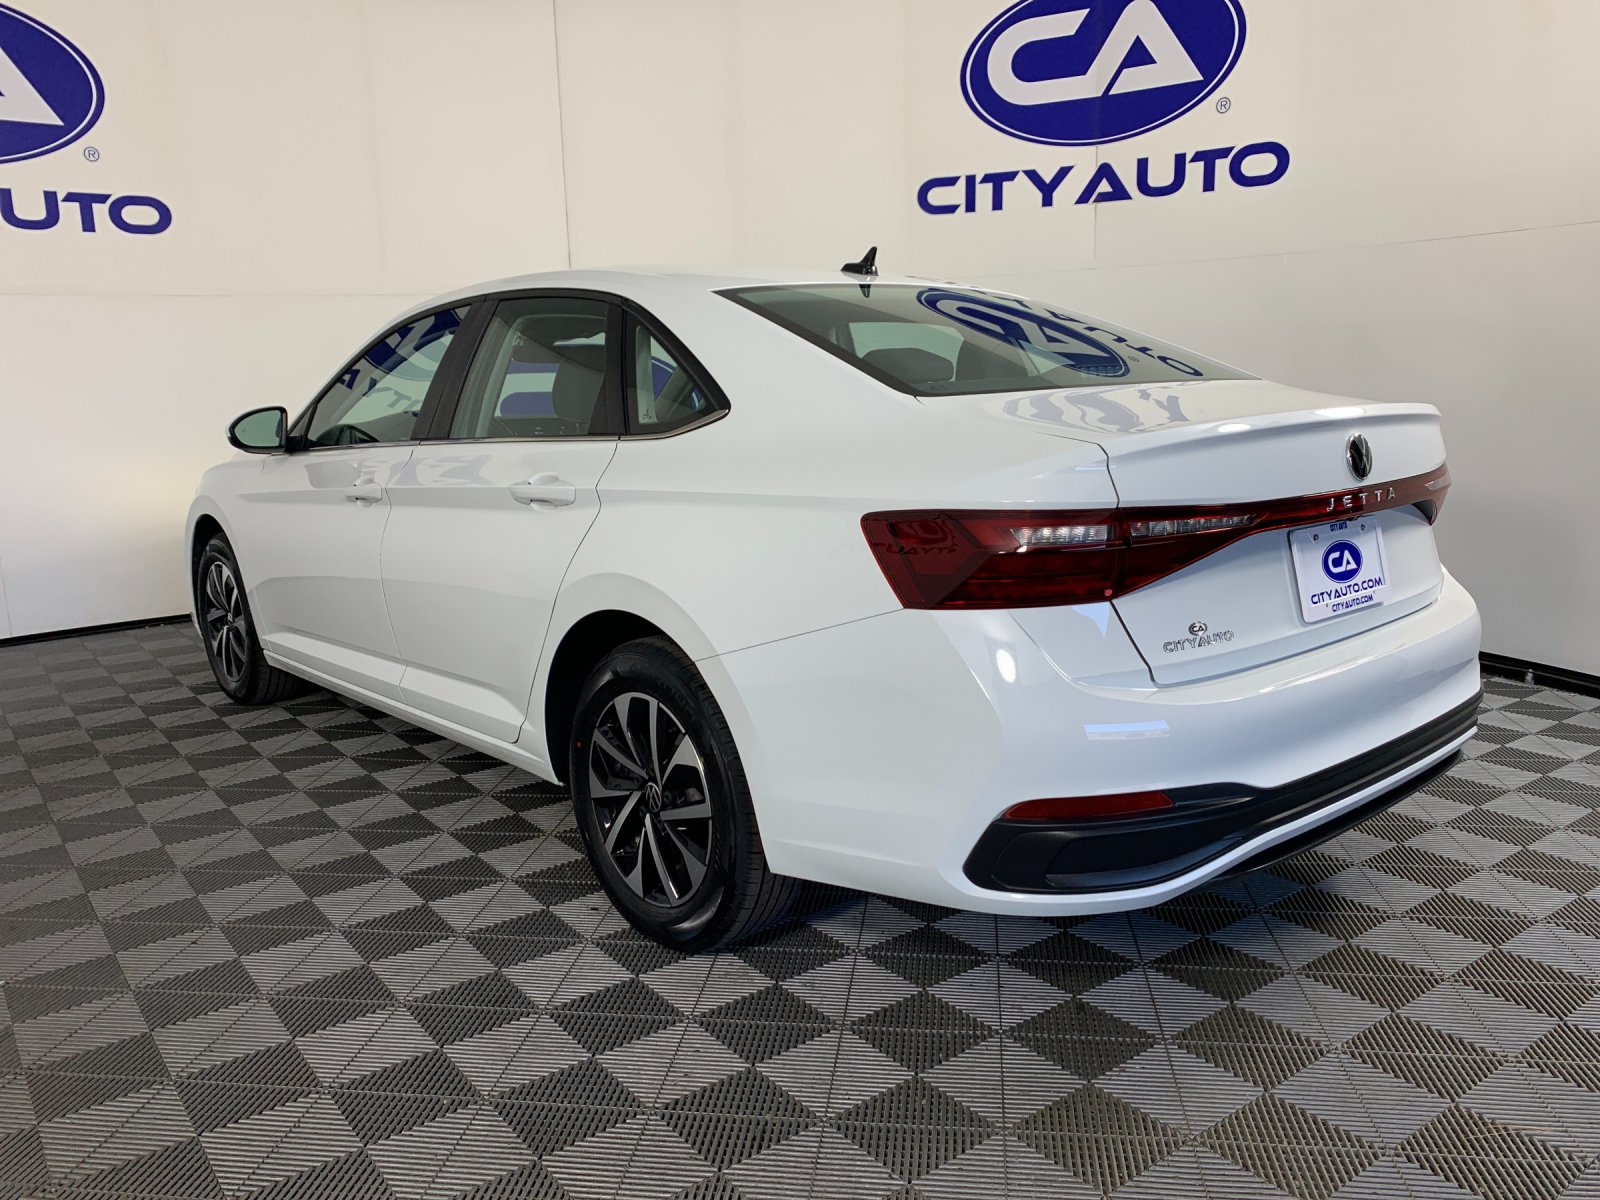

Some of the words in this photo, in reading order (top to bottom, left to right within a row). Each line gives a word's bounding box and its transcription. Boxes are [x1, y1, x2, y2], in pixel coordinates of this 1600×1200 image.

[987, 0, 1205, 106] CA
[0, 187, 172, 234] UTO
[1326, 487, 1396, 512] JETTA
[1327, 549, 1358, 574] CA
[1311, 577, 1383, 605] CITYAUTO.COM
[1332, 594, 1374, 612] CITYAUTO.COM
